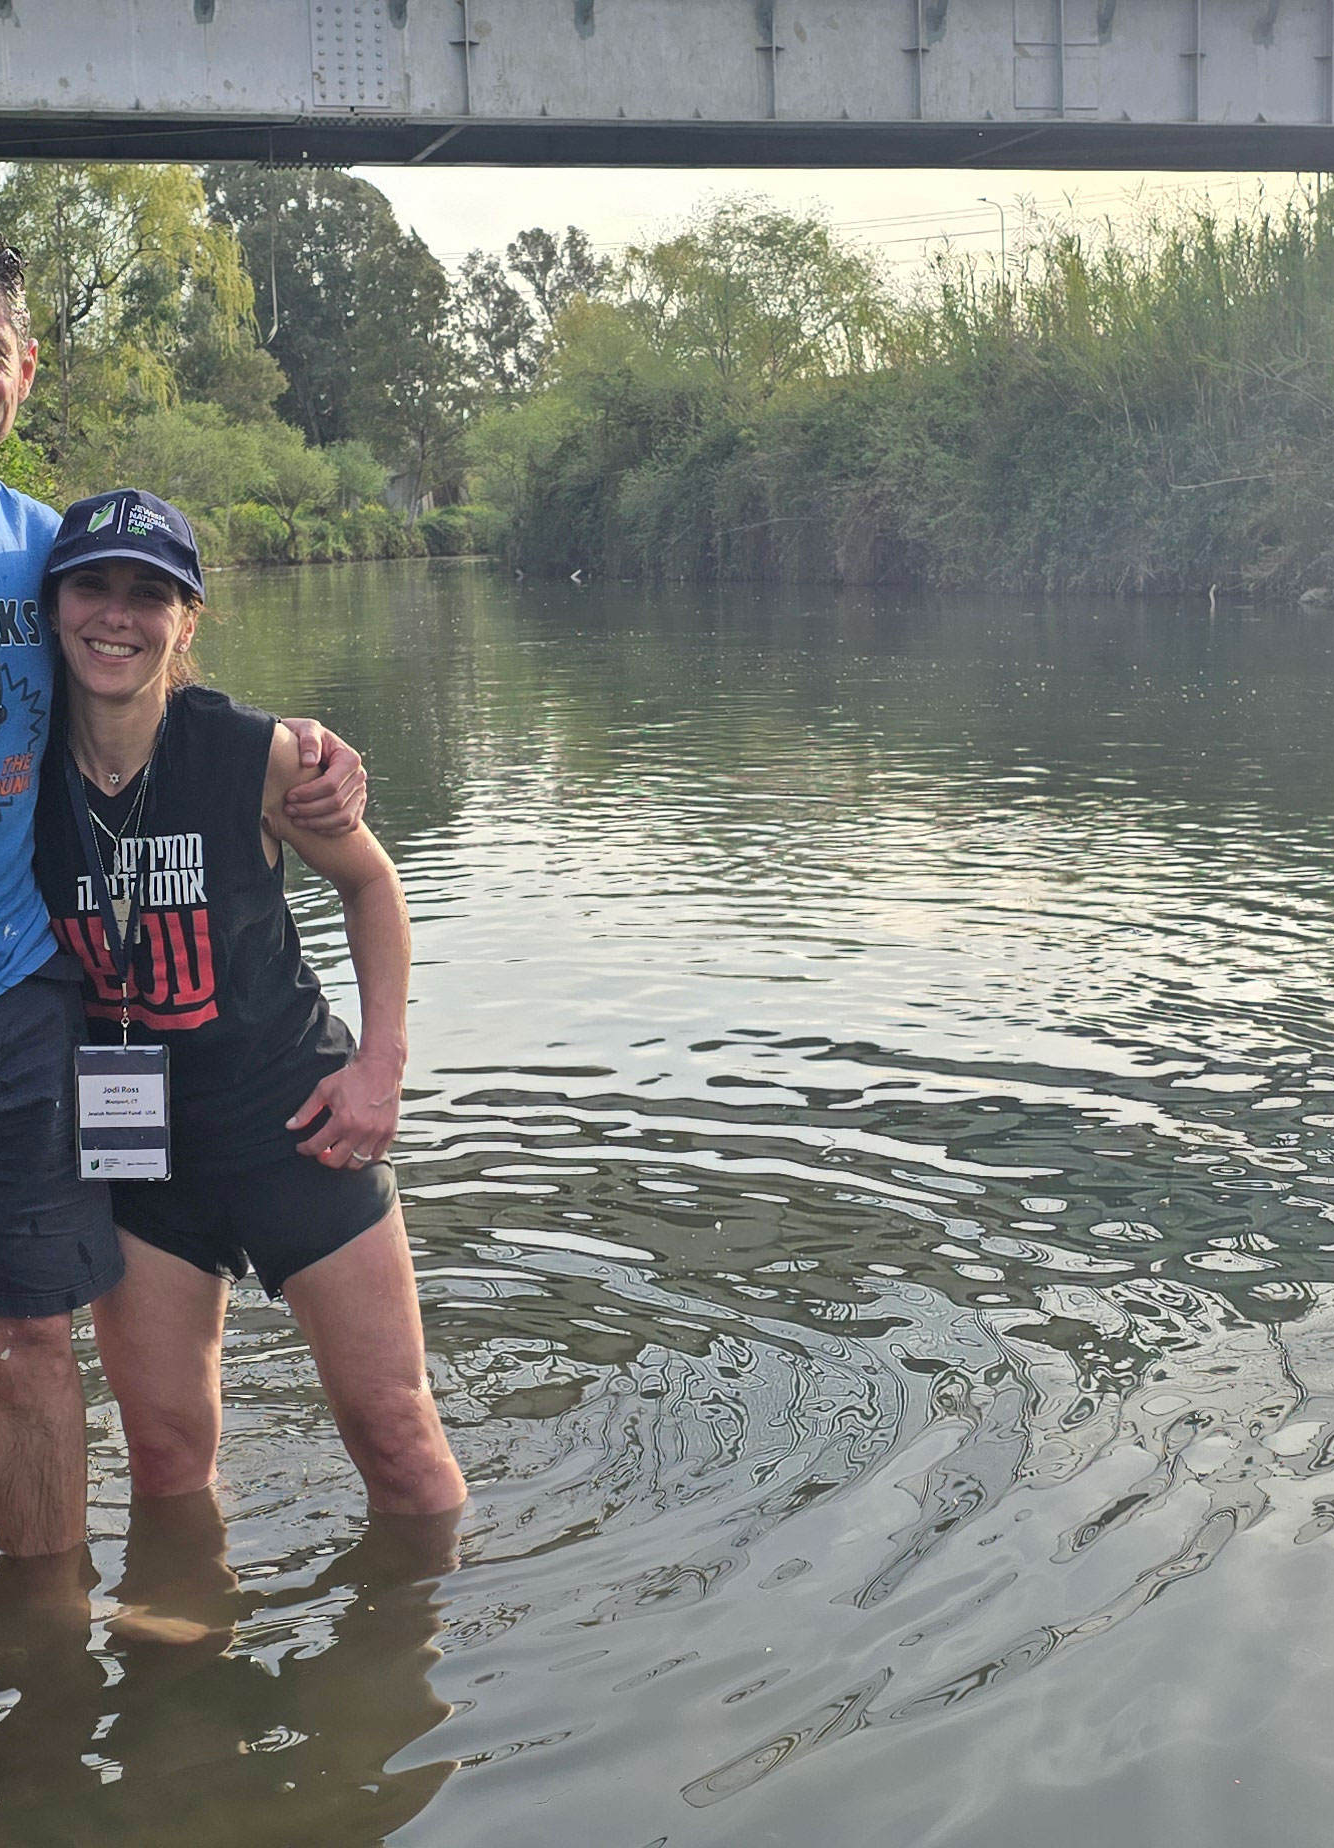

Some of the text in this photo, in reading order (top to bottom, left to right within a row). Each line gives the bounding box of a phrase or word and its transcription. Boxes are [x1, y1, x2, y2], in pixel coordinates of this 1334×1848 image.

[129, 511, 172, 533] NATIONAL
[131, 504, 165, 522] JEWISH
[127, 526, 147, 536] USA
[128, 519, 154, 530] FUND
[1, 753, 33, 776] THE
[120, 833, 204, 873] מחזירים
[149, 868, 208, 907] אותם
[103, 1086, 120, 1094] Jodi
